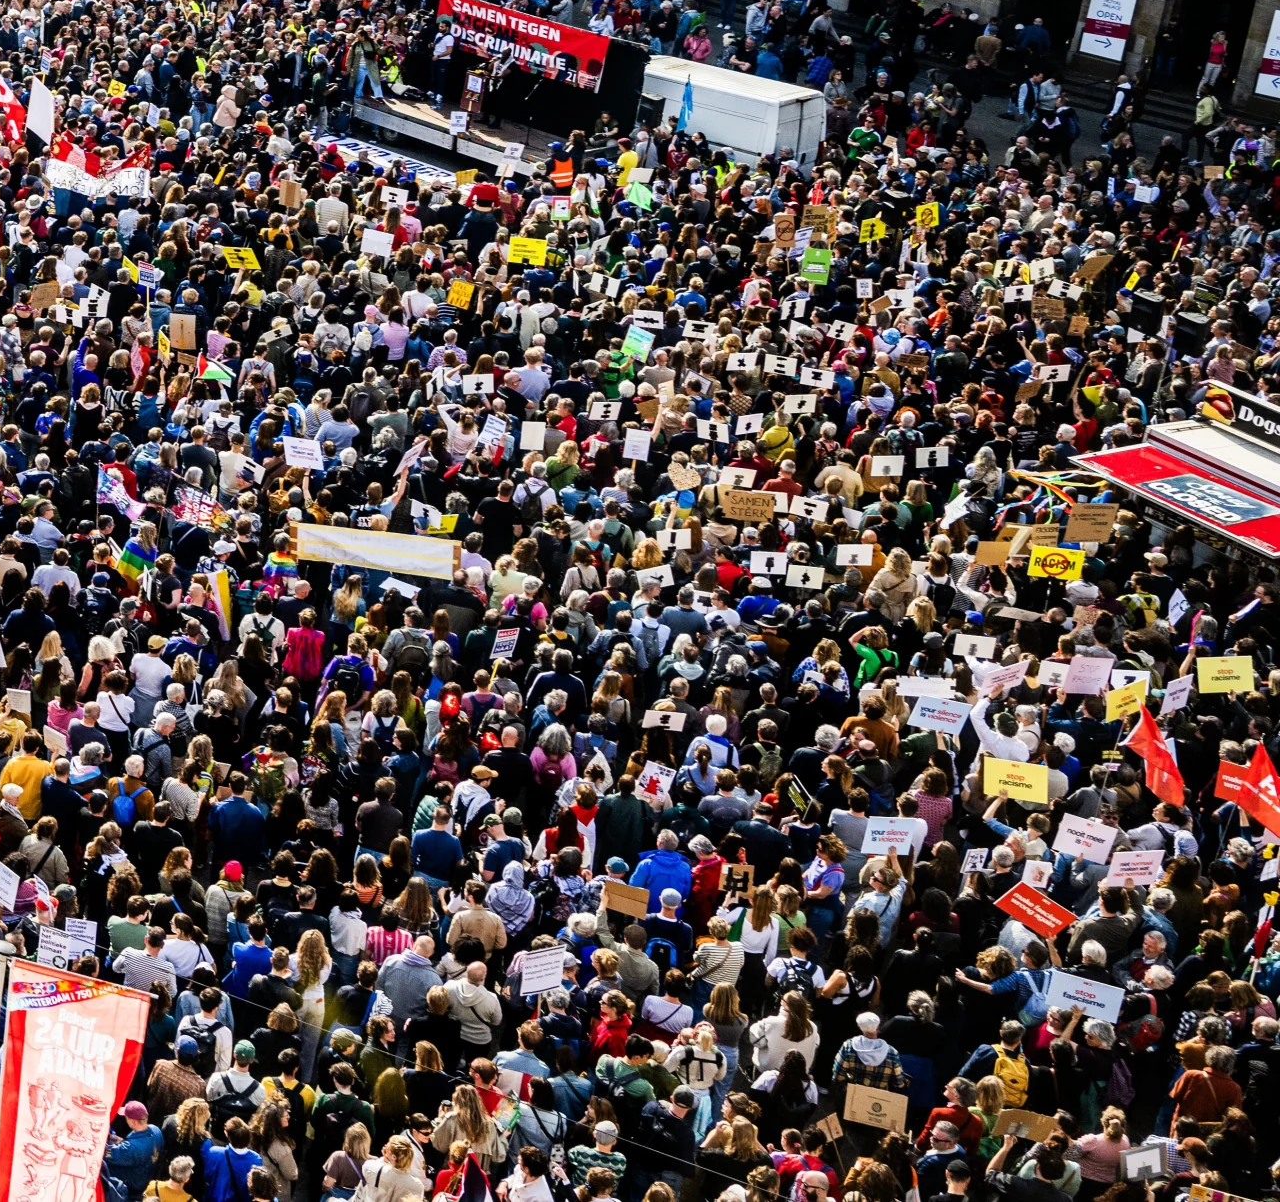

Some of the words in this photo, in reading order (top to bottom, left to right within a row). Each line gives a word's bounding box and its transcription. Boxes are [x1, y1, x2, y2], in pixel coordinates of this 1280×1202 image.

[452, 0, 506, 25] SAMEN
[509, 16, 560, 41] TEGEN
[1096, 10, 1123, 21] OPEN
[455, 11, 520, 42] RACISME
[449, 23, 566, 70] DISCRIMINATIE
[730, 495, 770, 507] SAMEN
[1146, 482, 1242, 523] CLOSED
[1034, 554, 1076, 573] RACISM
[1217, 669, 1233, 677] stop
[920, 706, 937, 715] your
[937, 710, 962, 718] silence
[928, 714, 957, 723] violence
[999, 780, 1032, 789] racisme
[1007, 774, 1024, 782] stop
[871, 830, 886, 838] your
[1067, 828, 1086, 838] nooit
[1086, 834, 1106, 844] meer
[1011, 898, 1034, 917] wrong
[1034, 910, 1055, 928] again
[1013, 893, 1034, 907] make
[1034, 903, 1061, 919] fascism
[39, 947, 62, 955] klimaat
[40, 940, 66, 949] politieke
[18, 993, 73, 1009] AMSTERDAM
[77, 989, 96, 1002] 750
[1063, 992, 1106, 1008] fascisme
[1075, 989, 1096, 1000] stop
[59, 1009, 97, 1031] Beleef
[35, 1016, 66, 1046] 24
[70, 1028, 116, 1061] UUR
